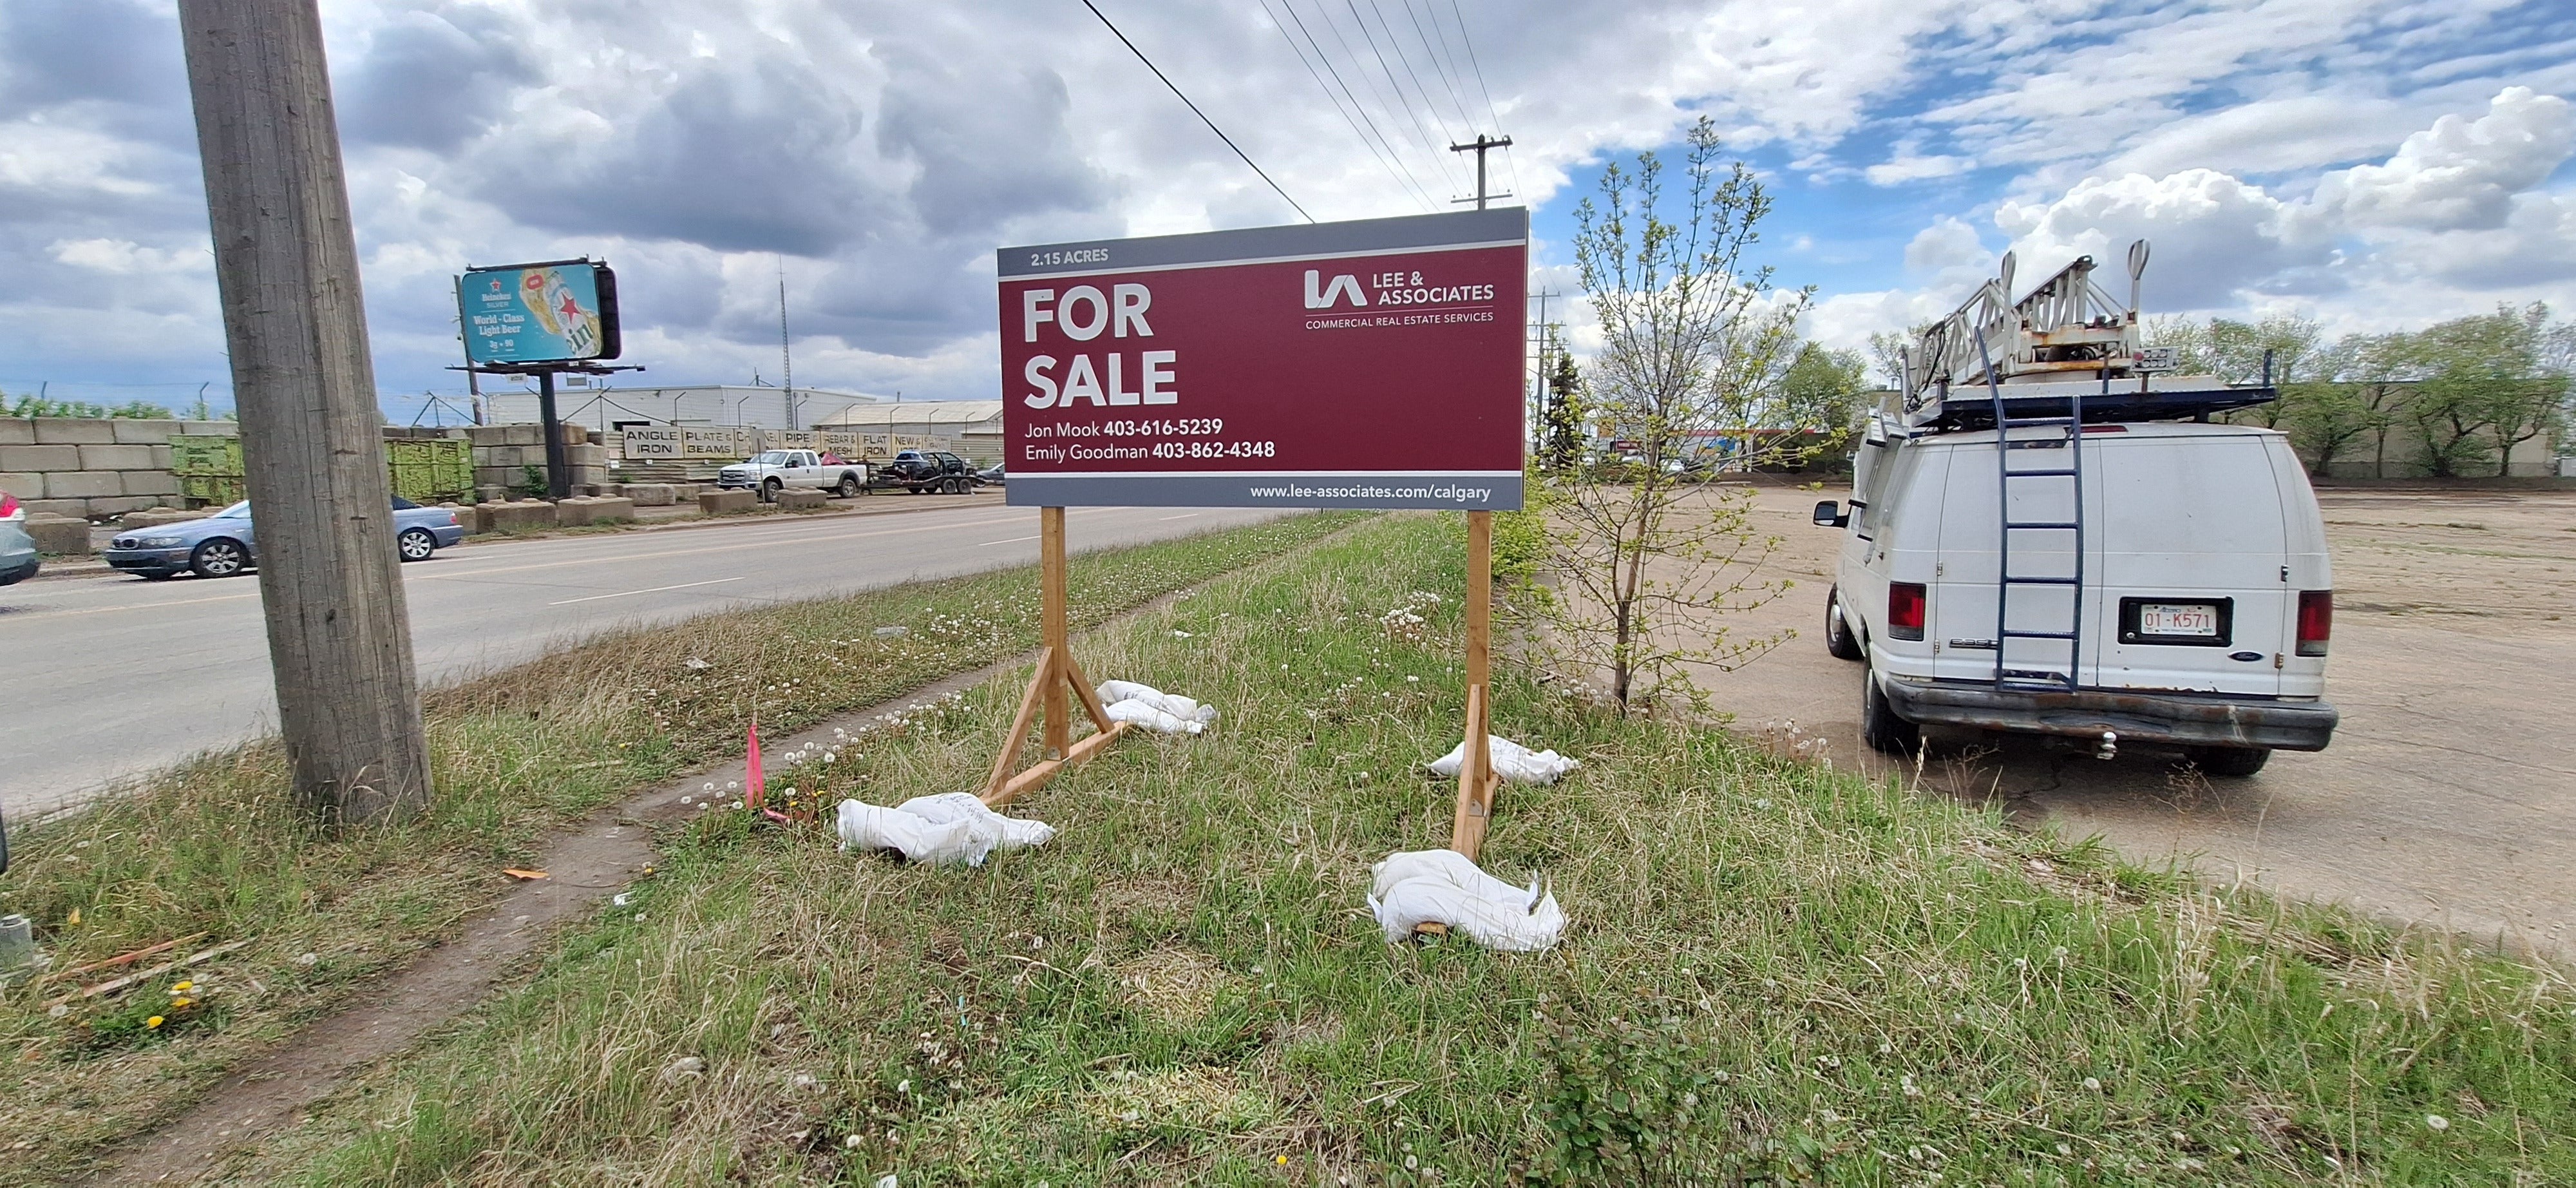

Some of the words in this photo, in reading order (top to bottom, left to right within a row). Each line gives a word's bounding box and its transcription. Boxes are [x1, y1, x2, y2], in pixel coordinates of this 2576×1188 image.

[1031, 252, 1061, 266] 2.15
[1063, 248, 1109, 264] ACRES
[1373, 272, 1405, 288] LEE
[1410, 271, 1423, 286] &
[1378, 284, 1494, 305] ASSOCIATES
[473, 314, 498, 325] World
[503, 313, 525, 323] Class
[1024, 283, 1154, 343] FOR
[1305, 318, 1373, 329] COMMERCIAL
[1376, 316, 1401, 326] REAL
[1405, 314, 1441, 325] ESTATE
[1444, 312, 1493, 323] SERVICES
[479, 325, 500, 337] Light
[502, 324, 522, 334] Beer
[1024, 350, 1178, 409] SALE
[1025, 423, 1052, 438] Jon
[1057, 421, 1101, 437] Mook
[1104, 418, 1224, 436] 403-616-5239
[627, 431, 678, 441] ANGLE
[686, 432, 724, 441] PLATE
[786, 433, 810, 443] PIPE
[825, 435, 849, 443] REBAR
[864, 436, 887, 444] FLAT
[895, 436, 914, 445] NEW
[637, 445, 672, 454] IRON
[687, 445, 731, 454] BEAMS
[864, 446, 887, 455] IRON
[1026, 444, 1066, 464] Emily
[1070, 443, 1148, 459] Goodman
[1152, 441, 1275, 458] 403-862-4348
[1250, 484, 1491, 502] www.lee-associates.com/calgary
